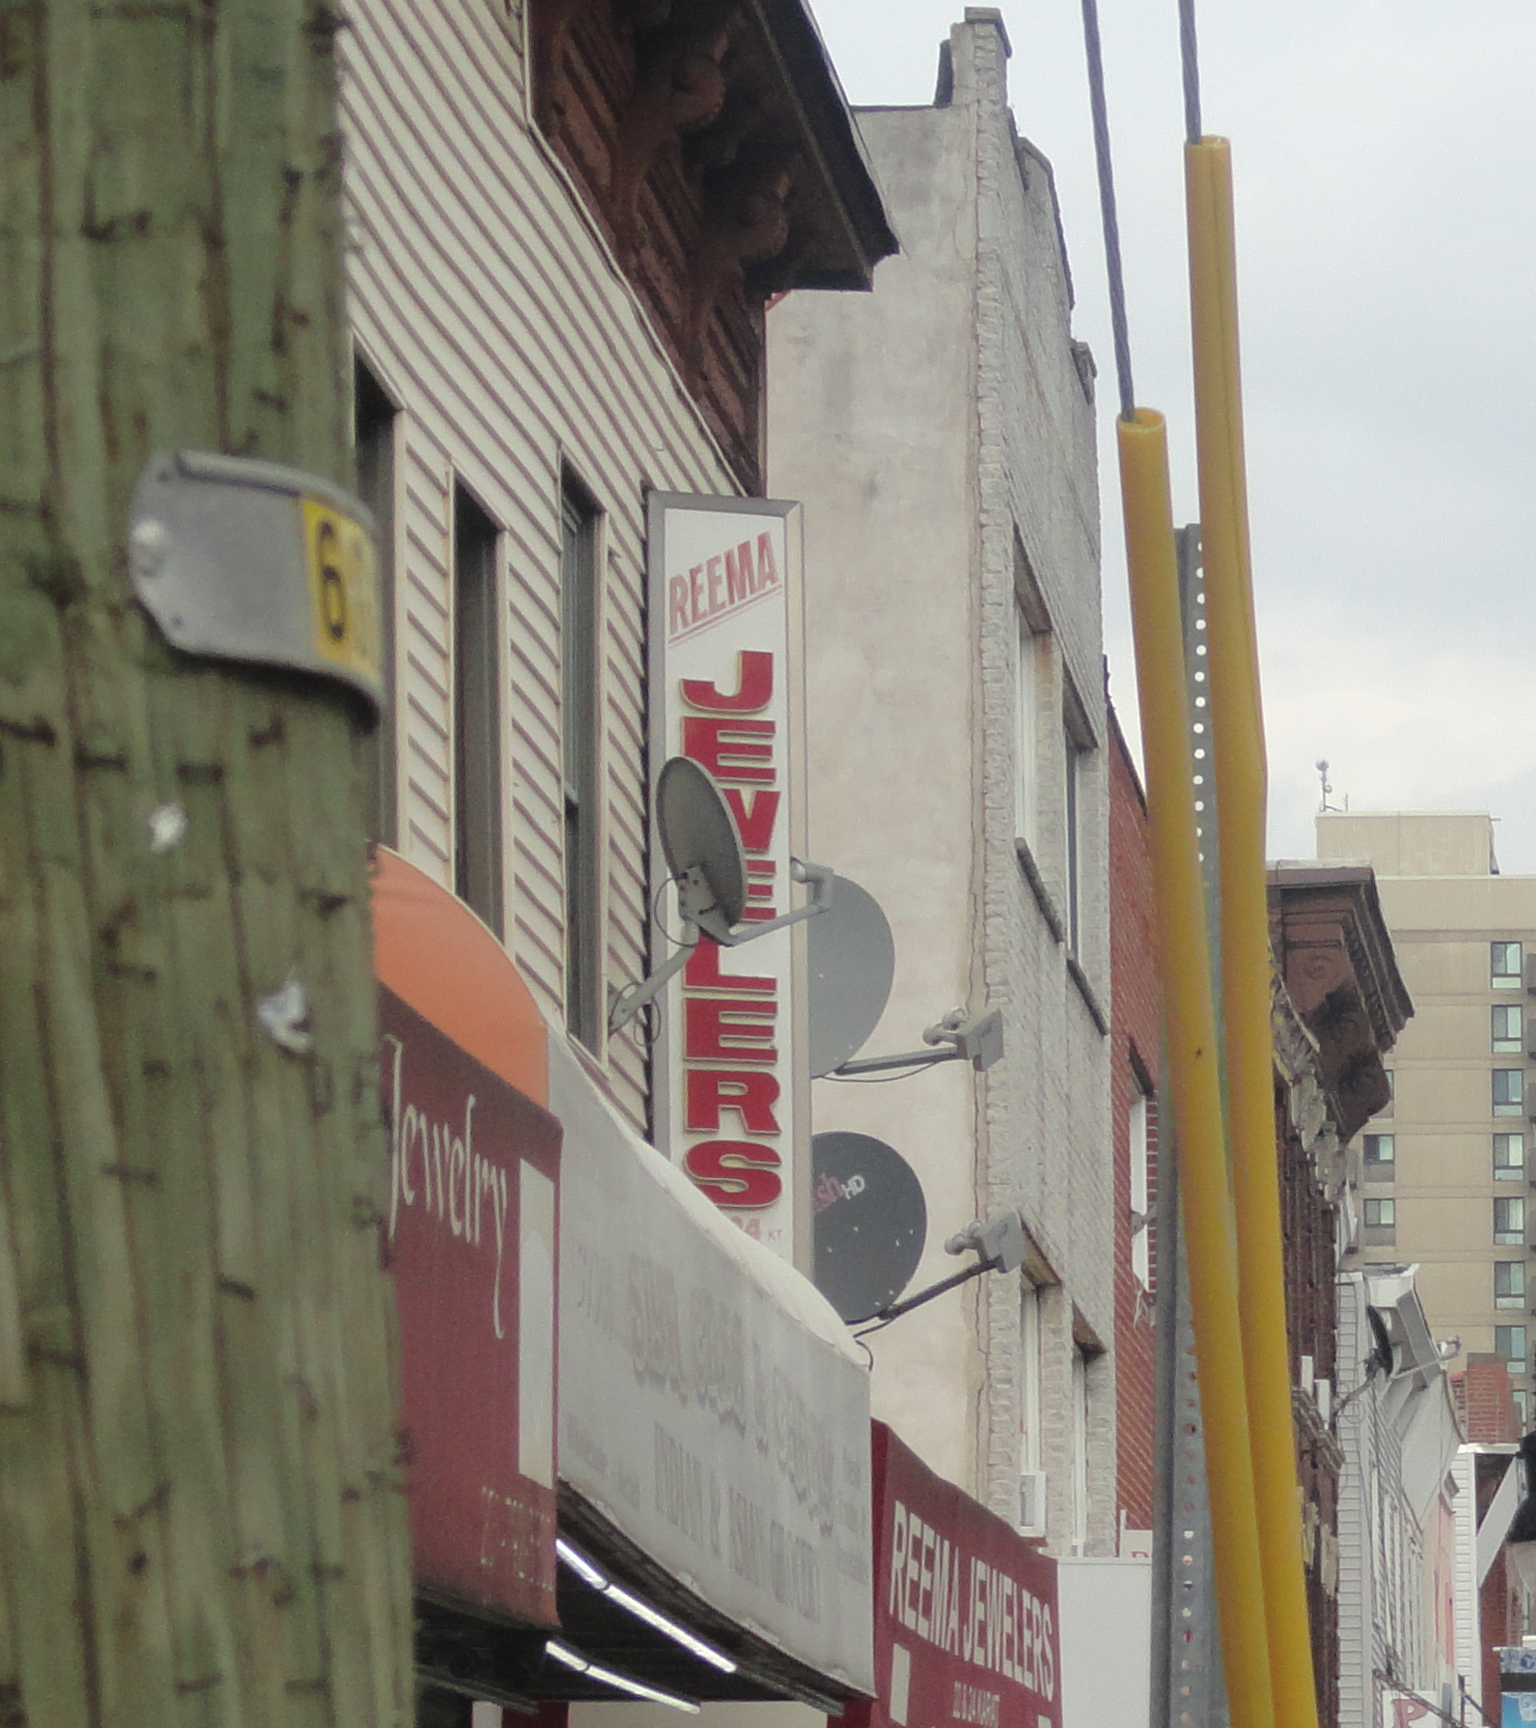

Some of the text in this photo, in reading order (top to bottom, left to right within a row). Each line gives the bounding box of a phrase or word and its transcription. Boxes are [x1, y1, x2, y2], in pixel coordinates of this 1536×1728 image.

[317, 516, 347, 644] 6
[668, 530, 780, 637] REEMA
[383, 1033, 507, 1339] Jewelry
[889, 1500, 960, 1656] REEMA
[963, 1556, 1054, 1702] JEWELERS
